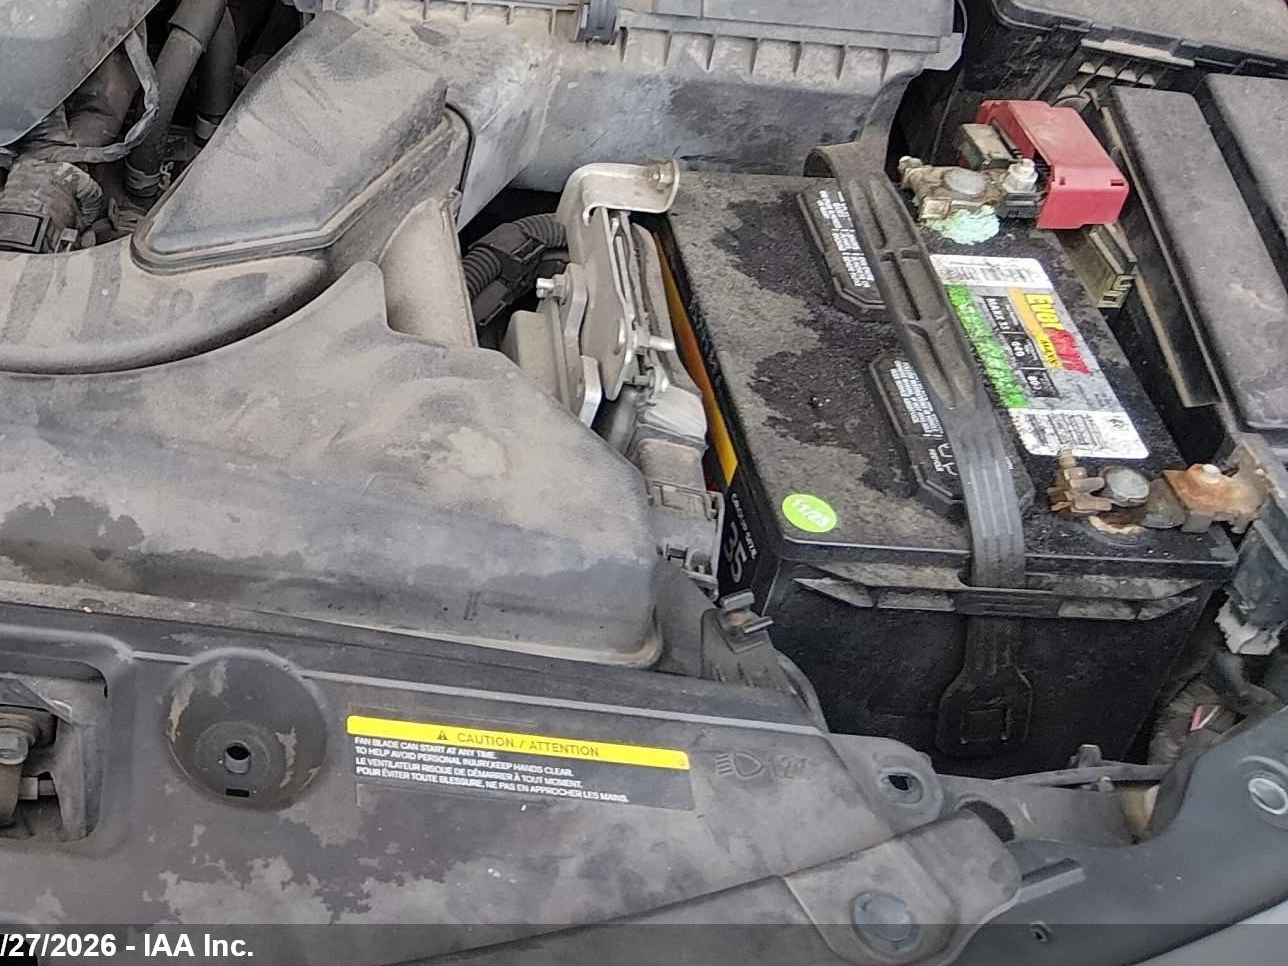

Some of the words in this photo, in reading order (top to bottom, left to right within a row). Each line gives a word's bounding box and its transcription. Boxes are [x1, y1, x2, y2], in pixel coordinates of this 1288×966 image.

[724, 521, 747, 583] 35
[355, 737, 371, 746] FAN
[372, 738, 399, 749] BLADE
[400, 741, 418, 750] CAN
[419, 744, 445, 754] START
[447, 747, 457, 755] AT
[458, 748, 475, 757] ANY
[457, 732, 514, 748] CAUTION
[529, 741, 600, 757] ATTENTION
[355, 746, 367, 755] TO
[369, 748, 390, 757] HELP
[390, 750, 416, 760] AVOID
[417, 753, 461, 765] PERSONAL
[513, 763, 543, 773] HANDS
[544, 767, 574, 777] CLEAR.
[356, 757, 367, 766] LE
[368, 758, 420, 771] VENTILATEUR
[422, 763, 453, 775] RISQUE
[454, 767, 466, 776] DE
[467, 767, 513, 782] DÉMARRER
[521, 774, 543, 783] TOUT
[544, 777, 583, 788] MOMENT.
[356, 767, 381, 777] POUR
[382, 768, 410, 780] ÉVITER
[411, 773, 438, 783] TOUTE
[439, 775, 485, 788] BLESSURE,
[486, 781, 498, 789] NE
[499, 783, 516, 791] PAS
[517, 784, 529, 793] EN
[529, 786, 582, 798] APPROCHER
[583, 790, 599, 799] LES
